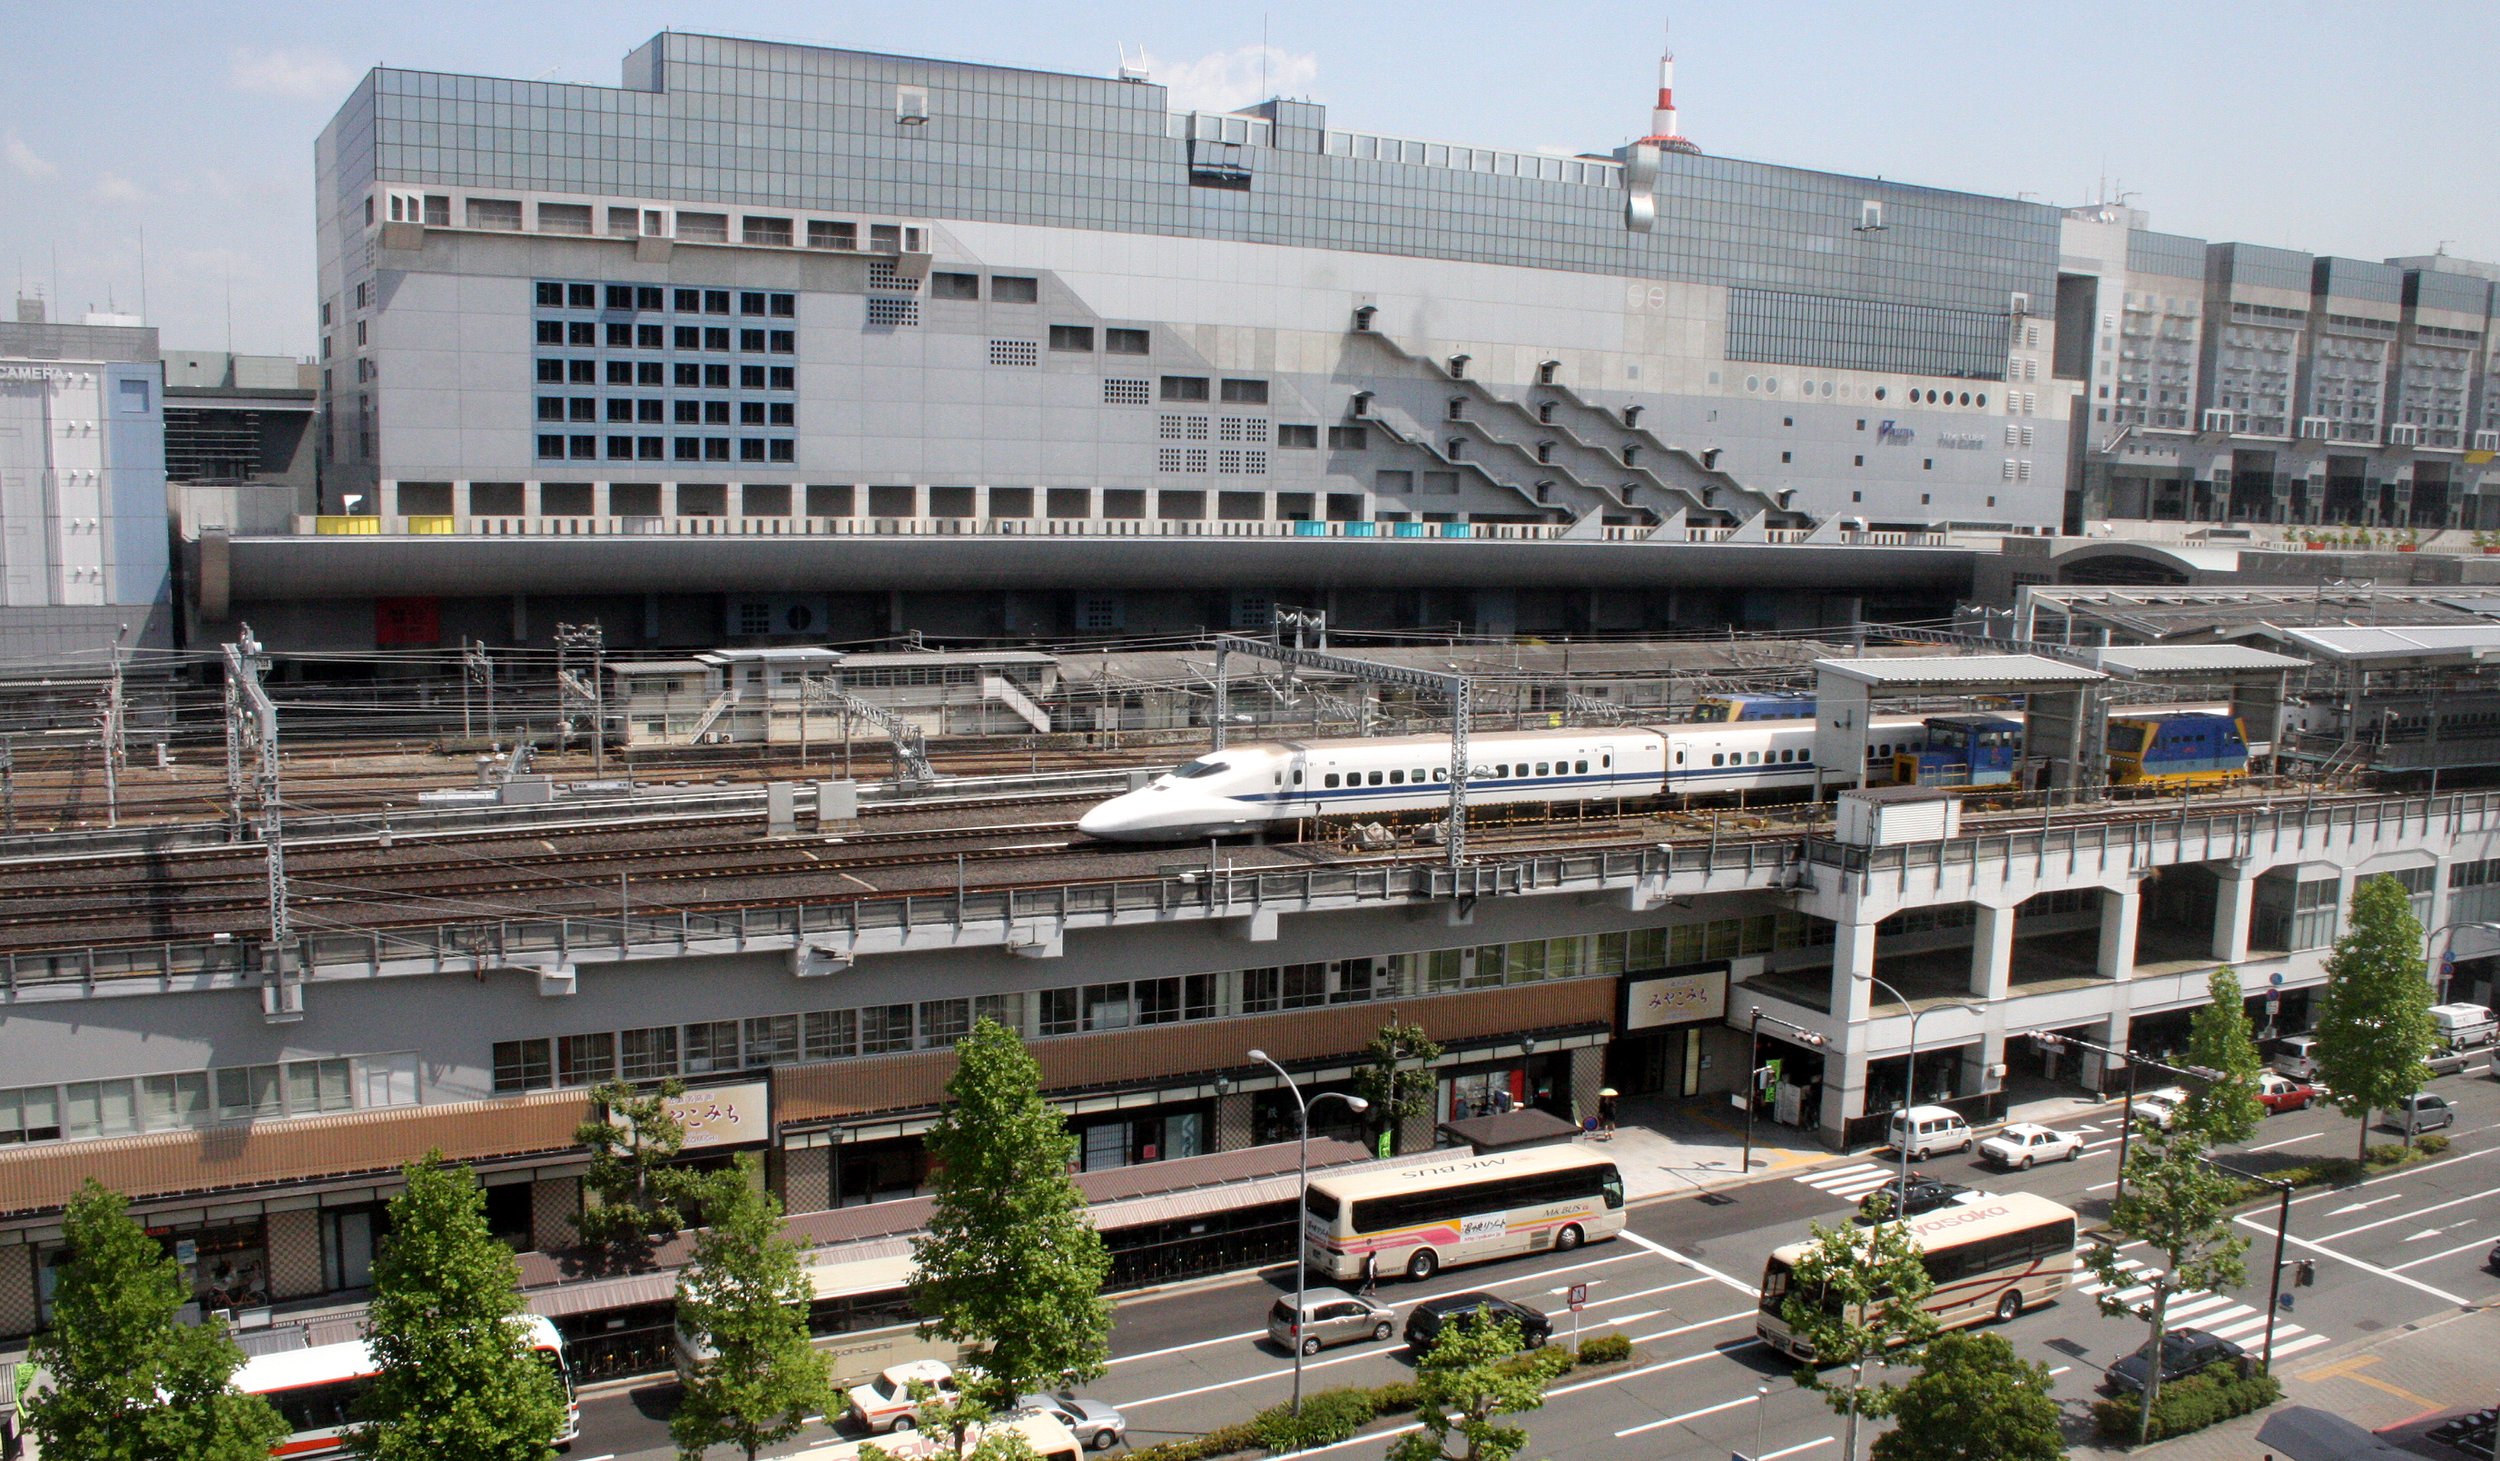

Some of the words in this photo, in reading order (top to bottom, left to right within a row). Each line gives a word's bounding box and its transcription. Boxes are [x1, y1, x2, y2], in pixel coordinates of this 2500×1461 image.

[1648, 988, 1708, 1008] みやこみち
[669, 1104, 740, 1127] やこみち
[1401, 1165, 1455, 1179] BUS
[1462, 1157, 1505, 1171] MK
[1543, 1208, 1560, 1217] MK
[1906, 1206, 2010, 1237] yasaka
